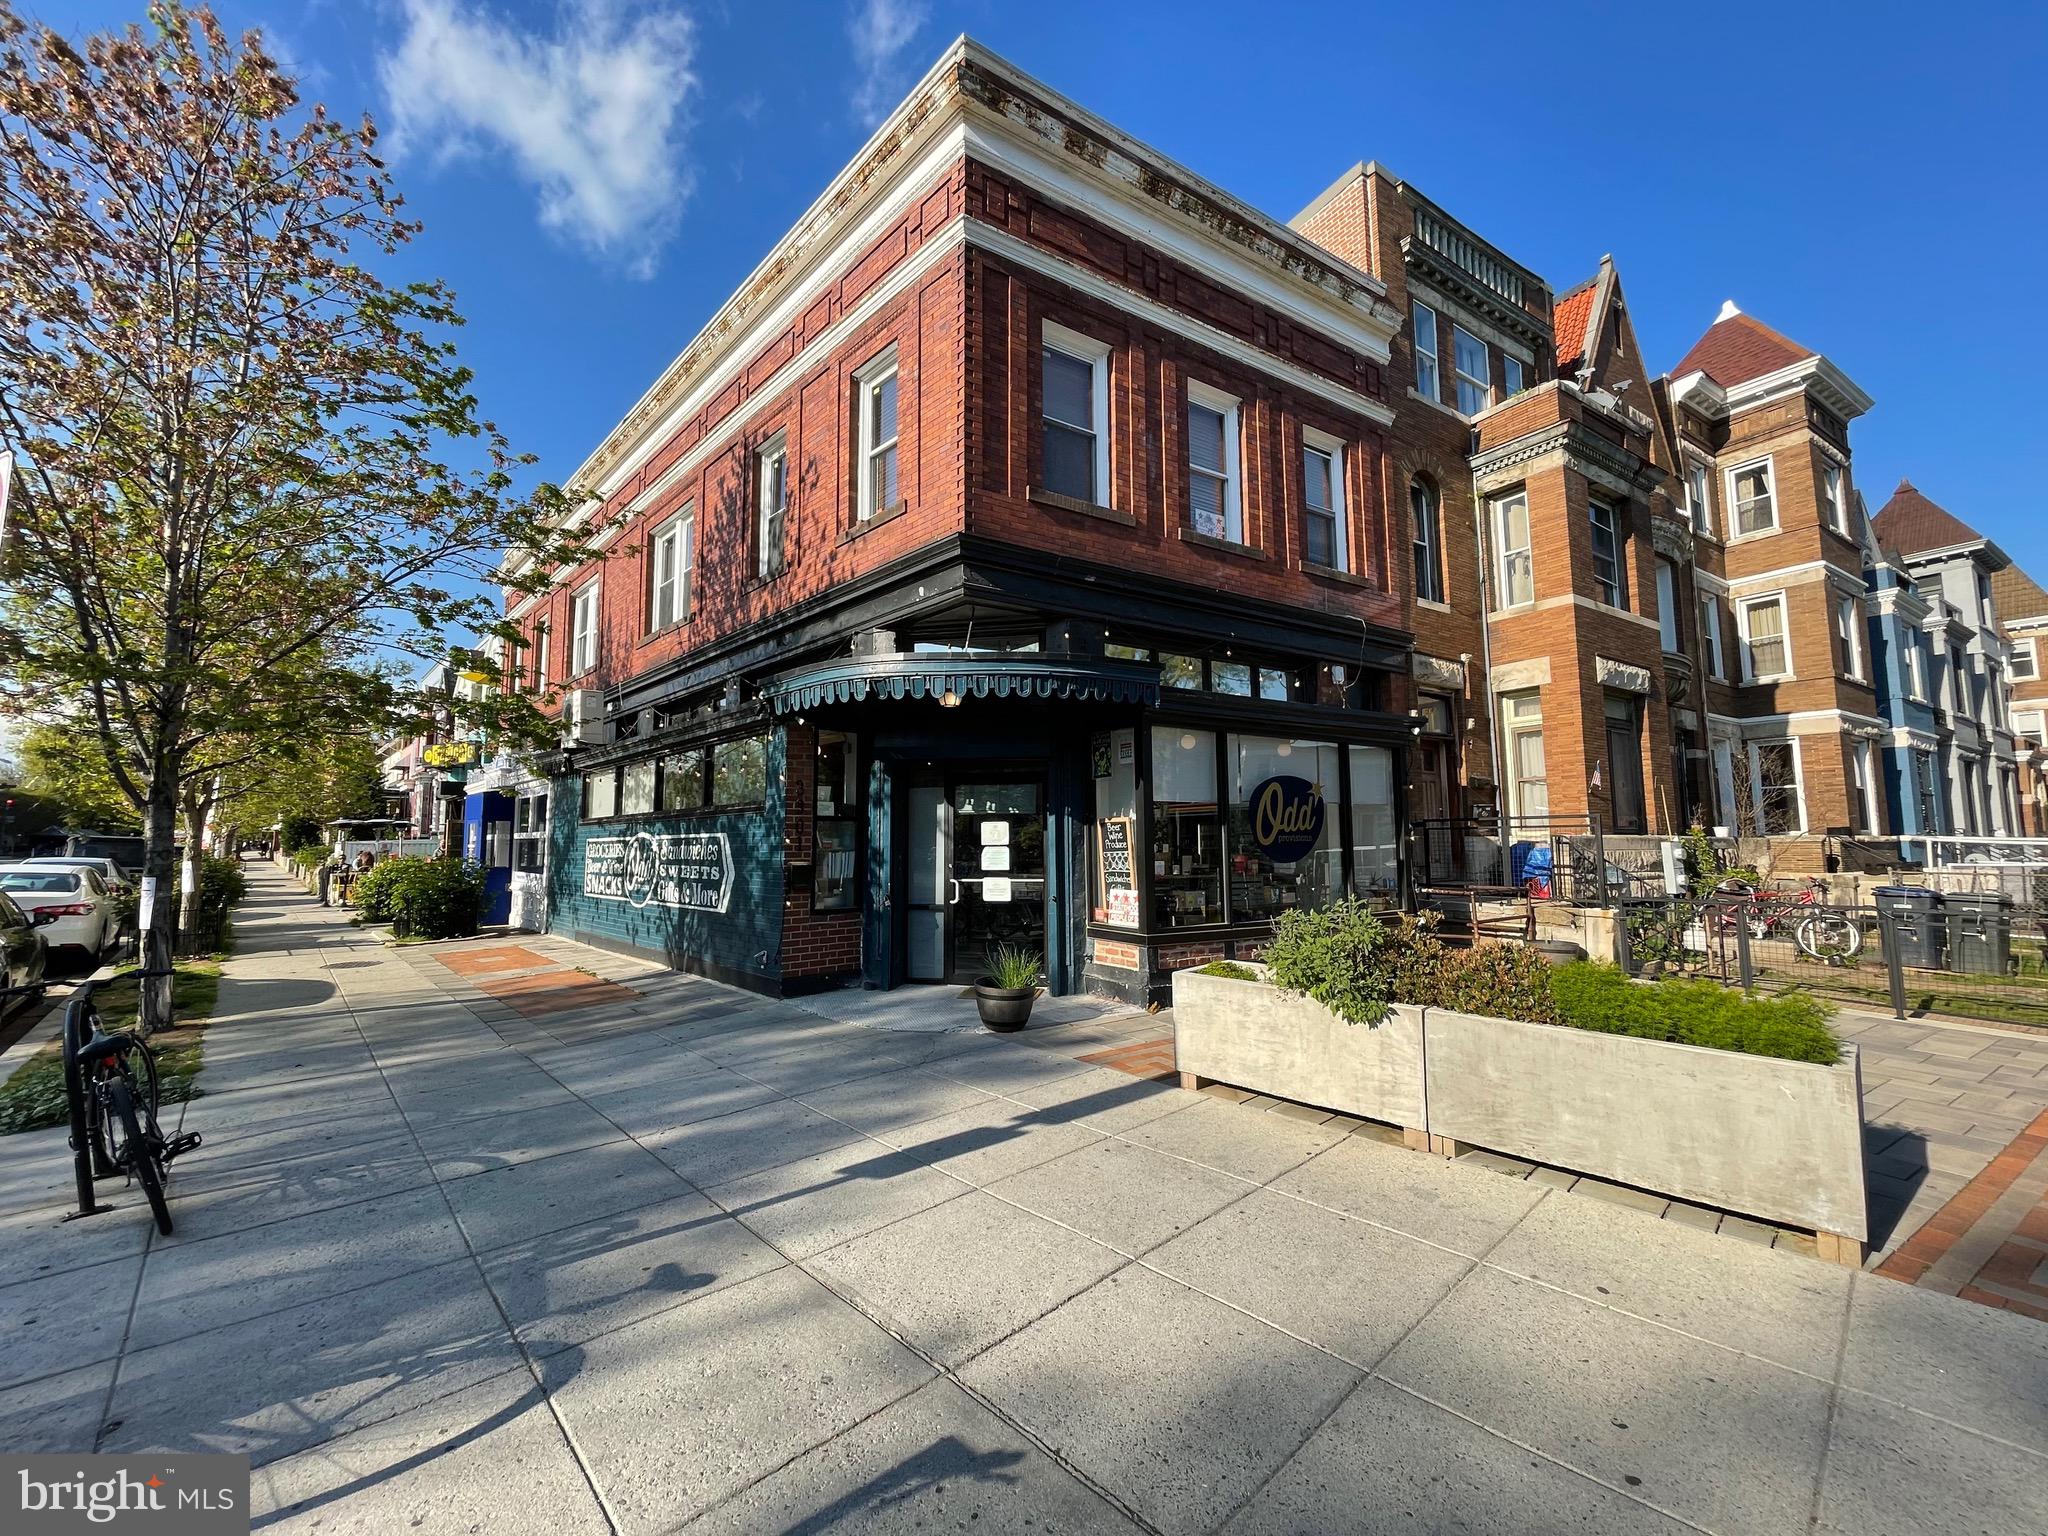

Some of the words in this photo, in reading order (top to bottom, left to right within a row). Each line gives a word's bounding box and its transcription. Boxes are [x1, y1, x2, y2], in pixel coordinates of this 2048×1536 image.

[1256, 782, 1316, 845] Odd
[1107, 823, 1121, 831] Beer
[1108, 832, 1123, 840] Wine
[588, 843, 625, 858] GROCERIES
[660, 839, 718, 860] Sandwiches
[1105, 839, 1127, 849] Produce
[659, 865, 720, 880] SWEETS
[586, 874, 622, 895] SNACKS
[657, 880, 679, 903] Gifts
[681, 882, 692, 904] &
[691, 883, 718, 906] More
